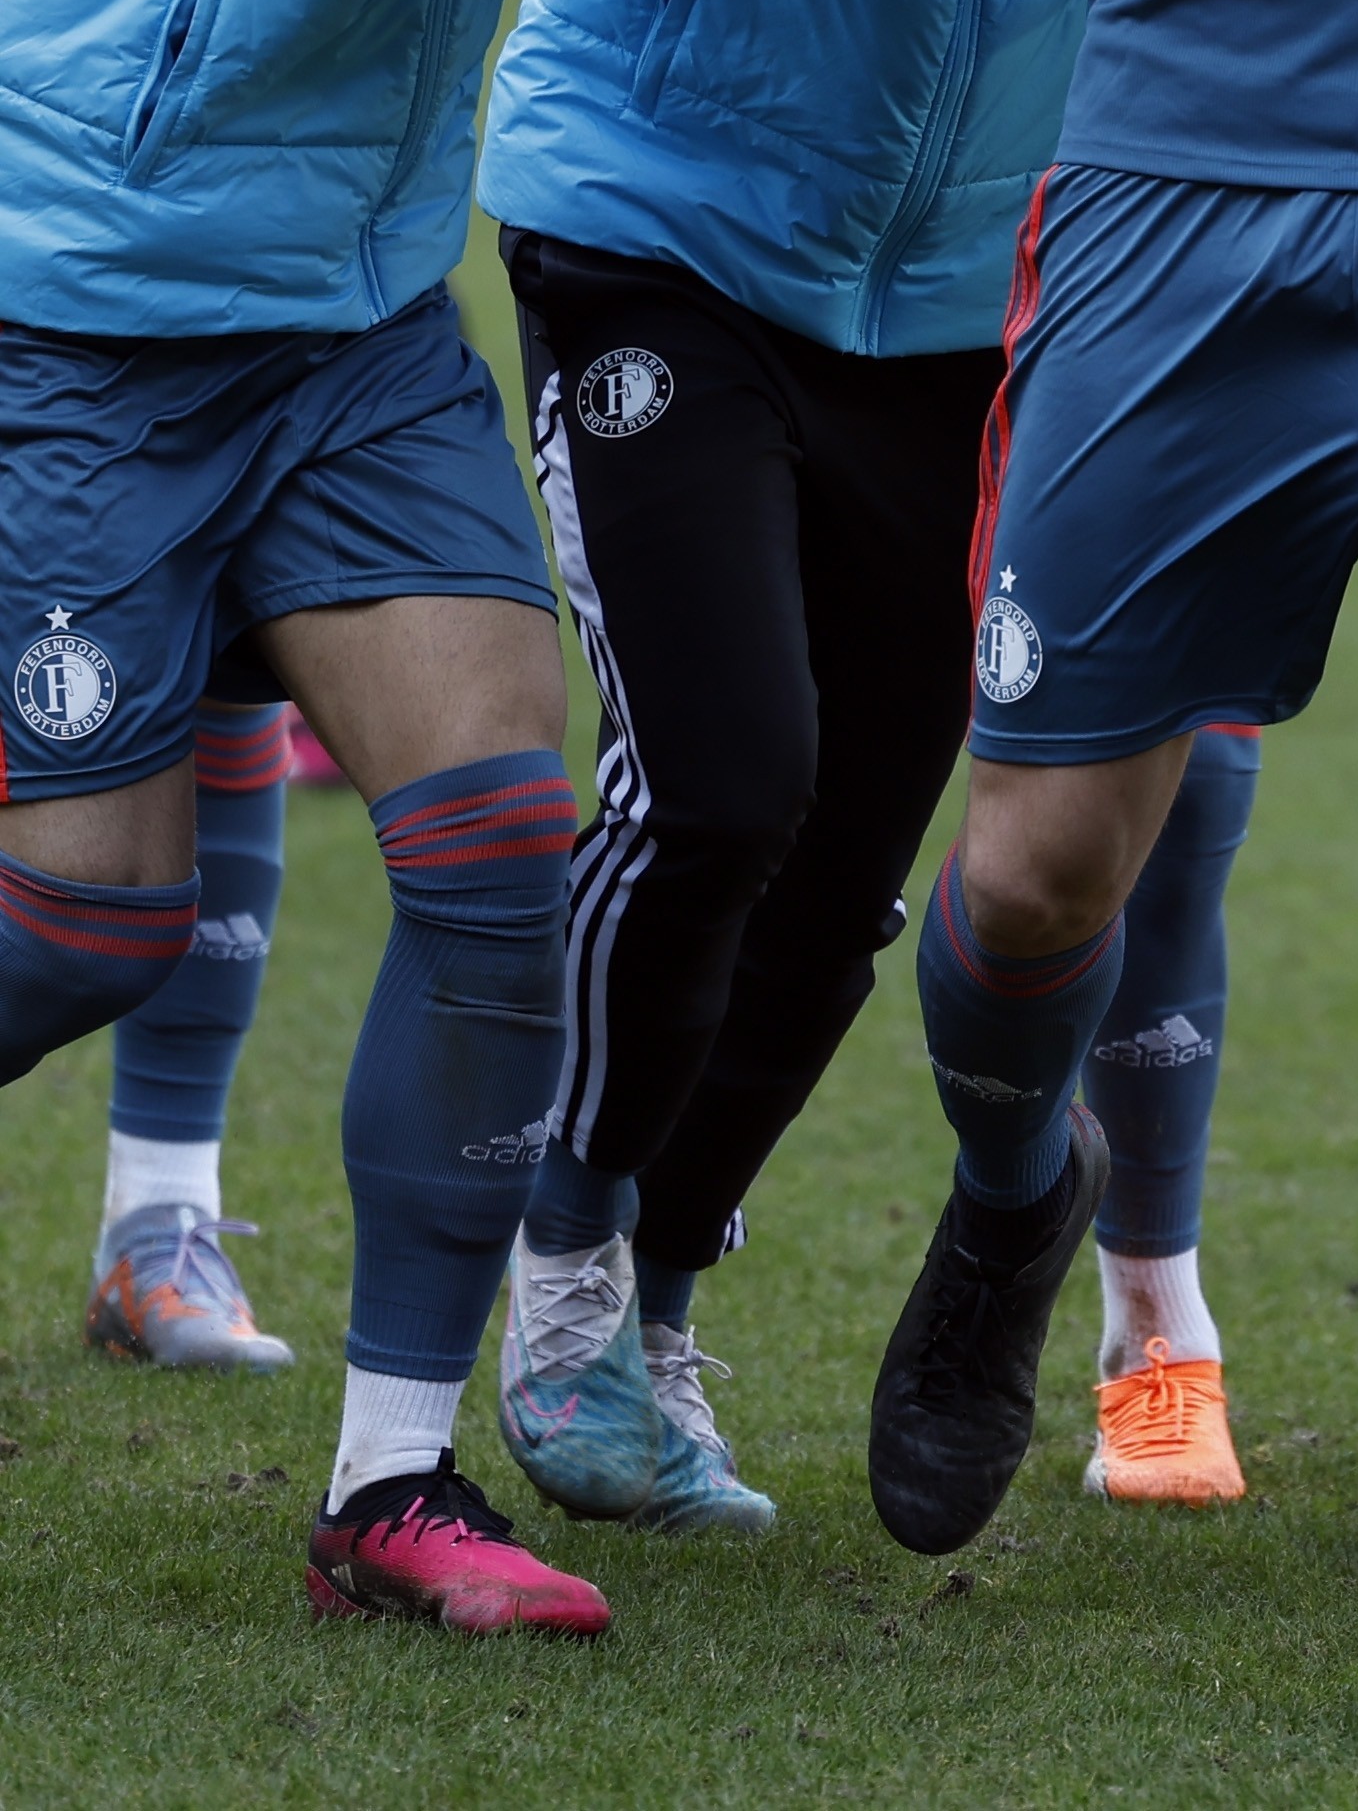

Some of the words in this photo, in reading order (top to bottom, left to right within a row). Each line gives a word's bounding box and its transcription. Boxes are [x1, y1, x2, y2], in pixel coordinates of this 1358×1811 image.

[583, 351, 665, 389] FEYENOORD
[584, 396, 665, 435] ROTTERDAM
[20, 639, 107, 676] FEYENOORD
[23, 697, 111, 737] ROTTERDAM
[1095, 1034, 1214, 1068] adidas
